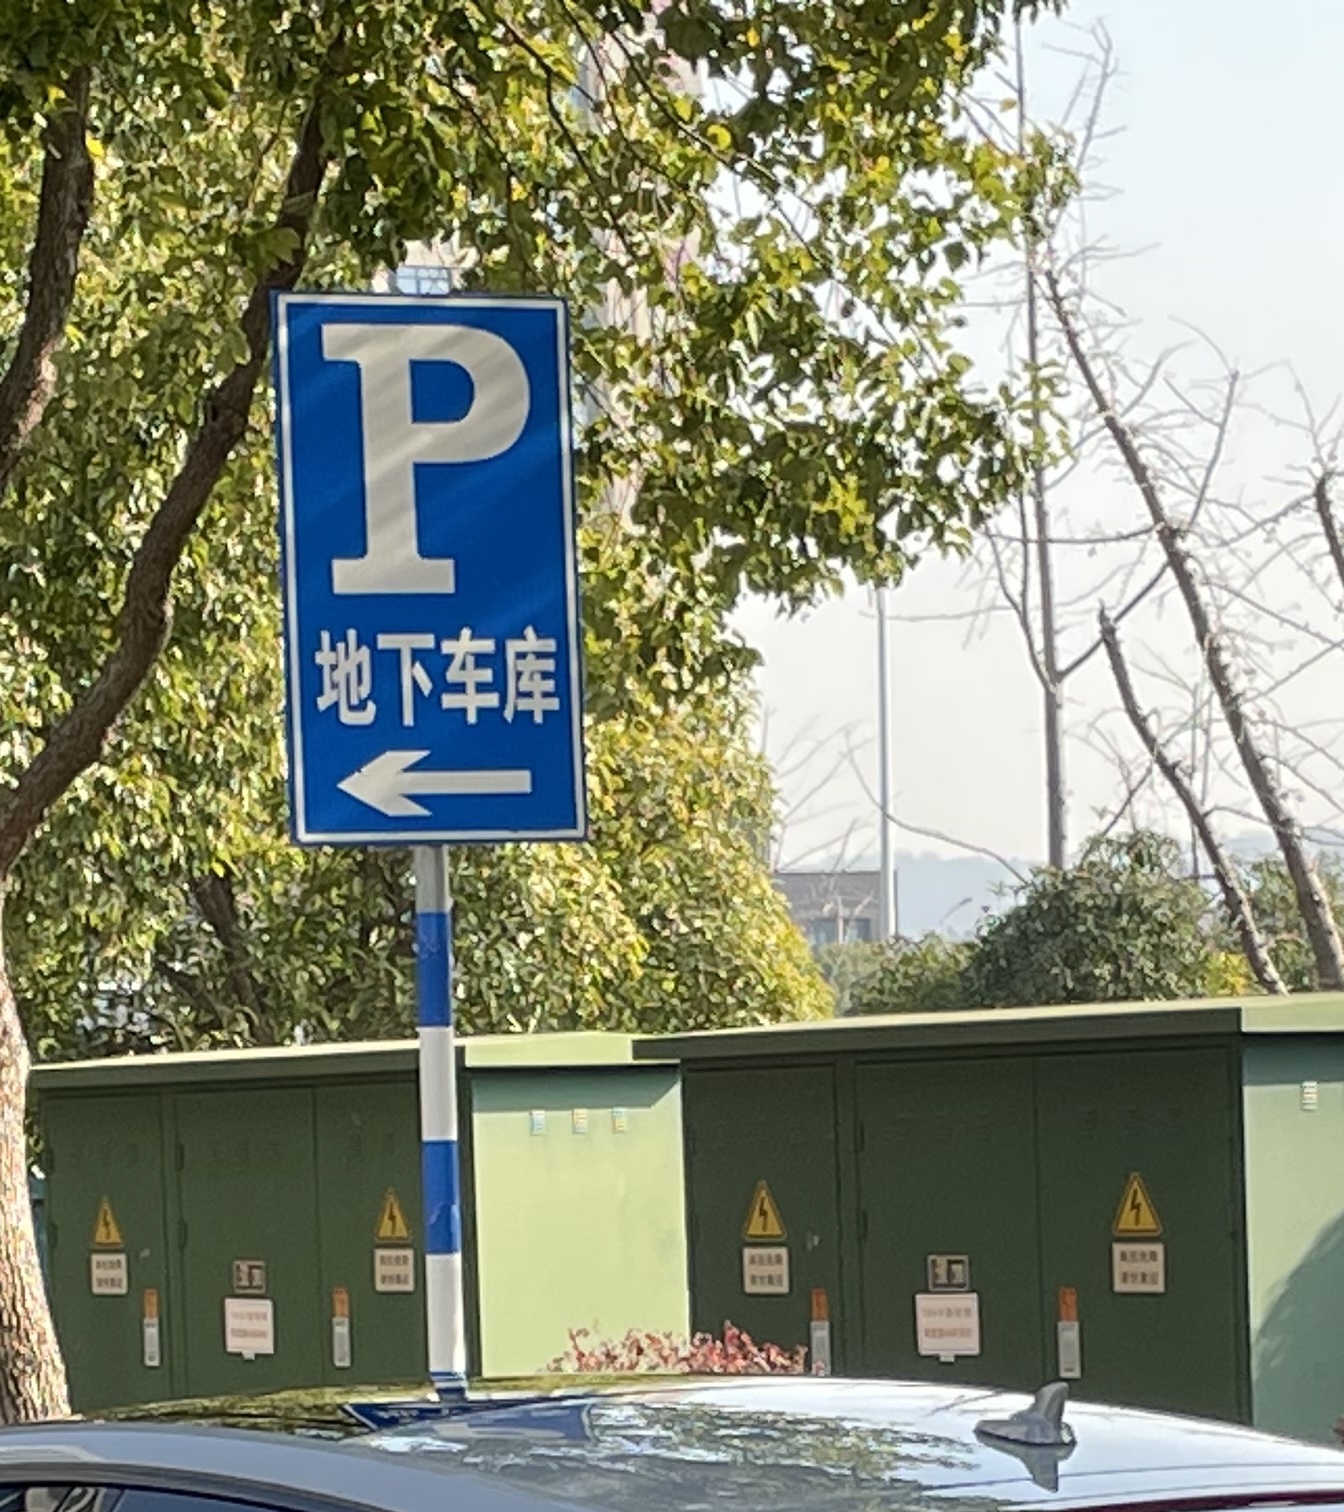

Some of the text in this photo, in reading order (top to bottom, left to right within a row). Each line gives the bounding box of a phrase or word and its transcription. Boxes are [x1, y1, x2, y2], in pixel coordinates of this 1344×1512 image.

[321, 323, 530, 594] P
[314, 625, 560, 727] 地下车库
